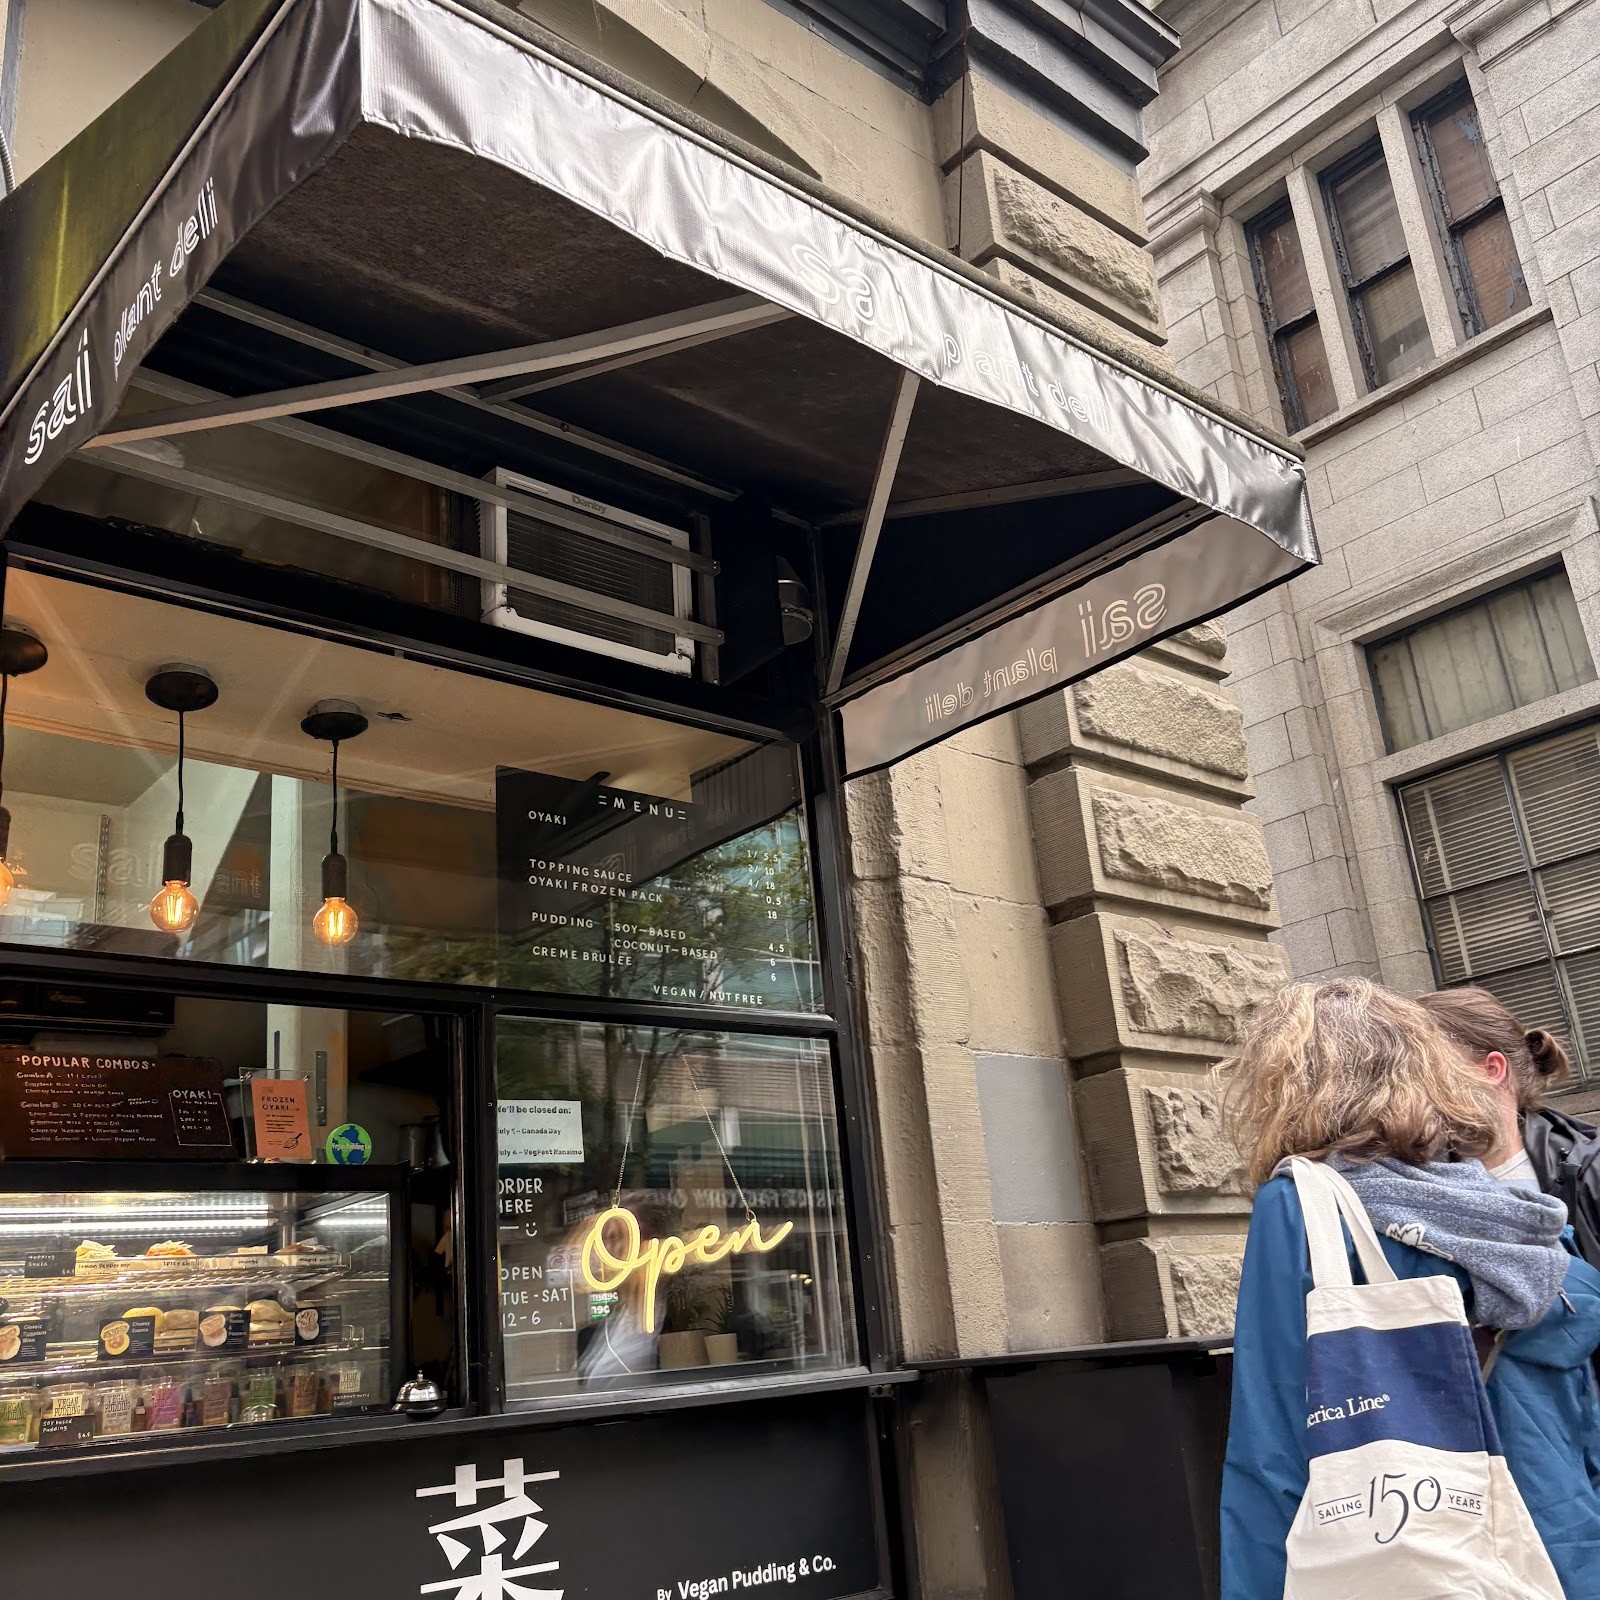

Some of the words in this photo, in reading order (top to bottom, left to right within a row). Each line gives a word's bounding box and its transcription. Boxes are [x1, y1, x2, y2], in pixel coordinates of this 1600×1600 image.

[113, 261, 162, 382] plant
[170, 177, 218, 278] deli
[571, 494, 607, 514] Danby
[612, 797, 675, 819] MENU
[528, 810, 568, 826] OYAKI
[763, 852, 779, 863] 5.5
[528, 858, 590, 877] TOPPING
[593, 868, 634, 883] SAUCE
[764, 866, 775, 876] 10
[528, 875, 569, 890] OYAKI
[572, 880, 627, 898] FROZEN
[631, 890, 663, 904] PACK
[765, 881, 776, 891] 18
[766, 895, 782, 906] 0.5
[531, 912, 594, 929] PUDDING
[767, 910, 778, 920] 18
[532, 945, 578, 961] CREME
[582, 950, 633, 966] BRULEE
[768, 943, 785, 953] 4.5
[769, 957, 776, 967] 6
[770, 972, 777, 982] 6
[653, 984, 697, 998] VEGAN
[21, 1055, 90, 1069] POPULAR
[96, 1058, 149, 1070] COMBOS
[172, 1089, 212, 1099] OYAKI
[516, 1105, 528, 1113] be
[529, 1105, 557, 1114] closed
[499, 1128, 510, 1136] uly
[499, 1149, 511, 1157] uly
[500, 1265, 543, 1281] OPEN
[581, 1207, 794, 1334] Open
[1307, 1404, 1345, 1428] erica
[1318, 1499, 1363, 1520] SAILING
[1368, 1472, 1442, 1544] 150
[1448, 1493, 1482, 1510] YEARS
[415, 1457, 565, 1600] 菜
[656, 1588, 672, 1600] By
[677, 1576, 728, 1600] Vegan
[731, 1562, 797, 1589] Pudding
[798, 1557, 811, 1575] &
[812, 1555, 837, 1573] Co.
